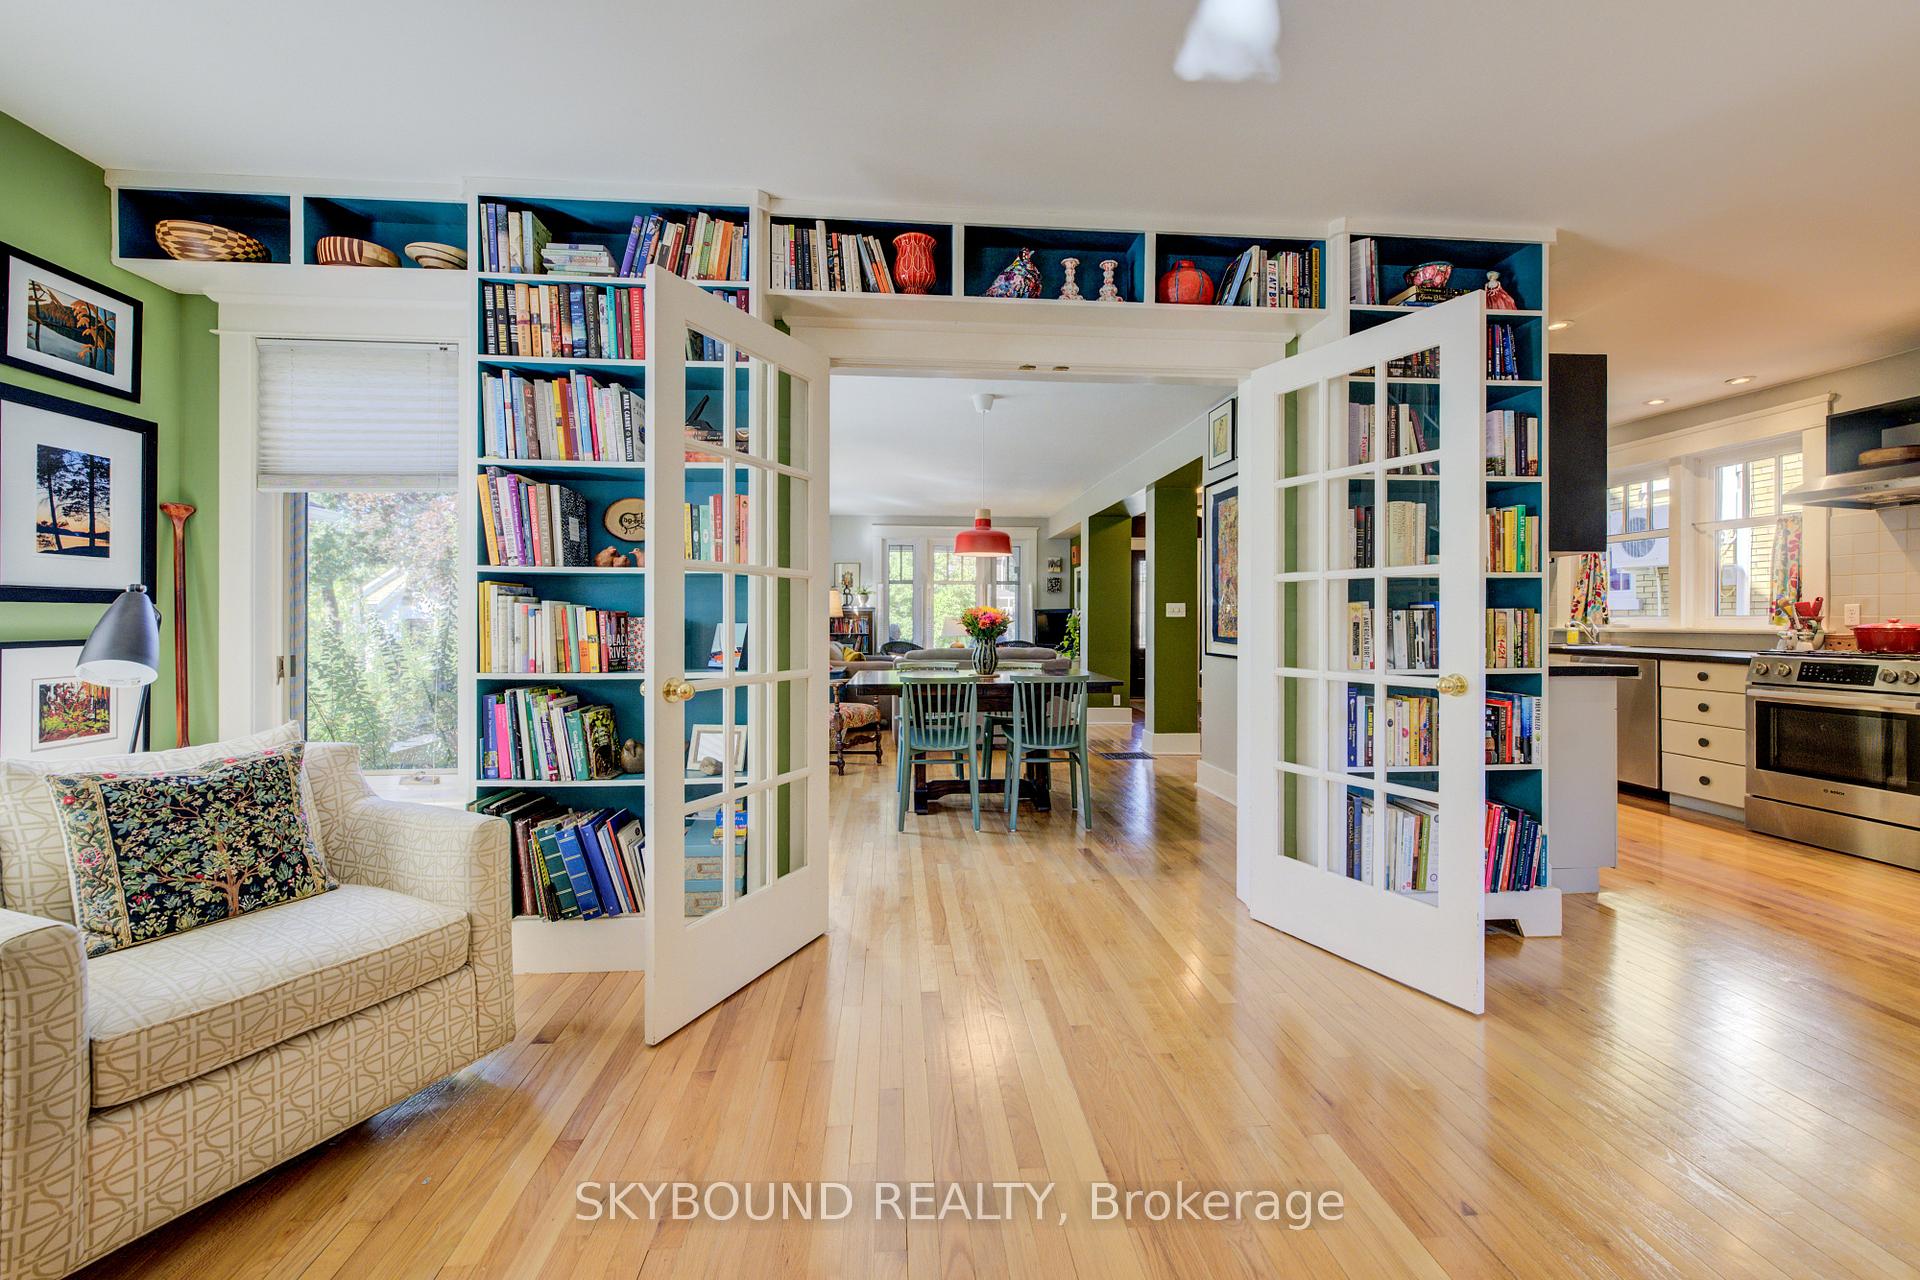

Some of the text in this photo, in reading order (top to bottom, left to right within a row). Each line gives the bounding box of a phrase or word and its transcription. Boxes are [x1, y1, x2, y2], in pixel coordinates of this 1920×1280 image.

[491, 489, 500, 512] KEMP
[539, 495, 548, 519] SENSE
[541, 520, 548, 530] OF
[1497, 640, 1505, 659] 1421
